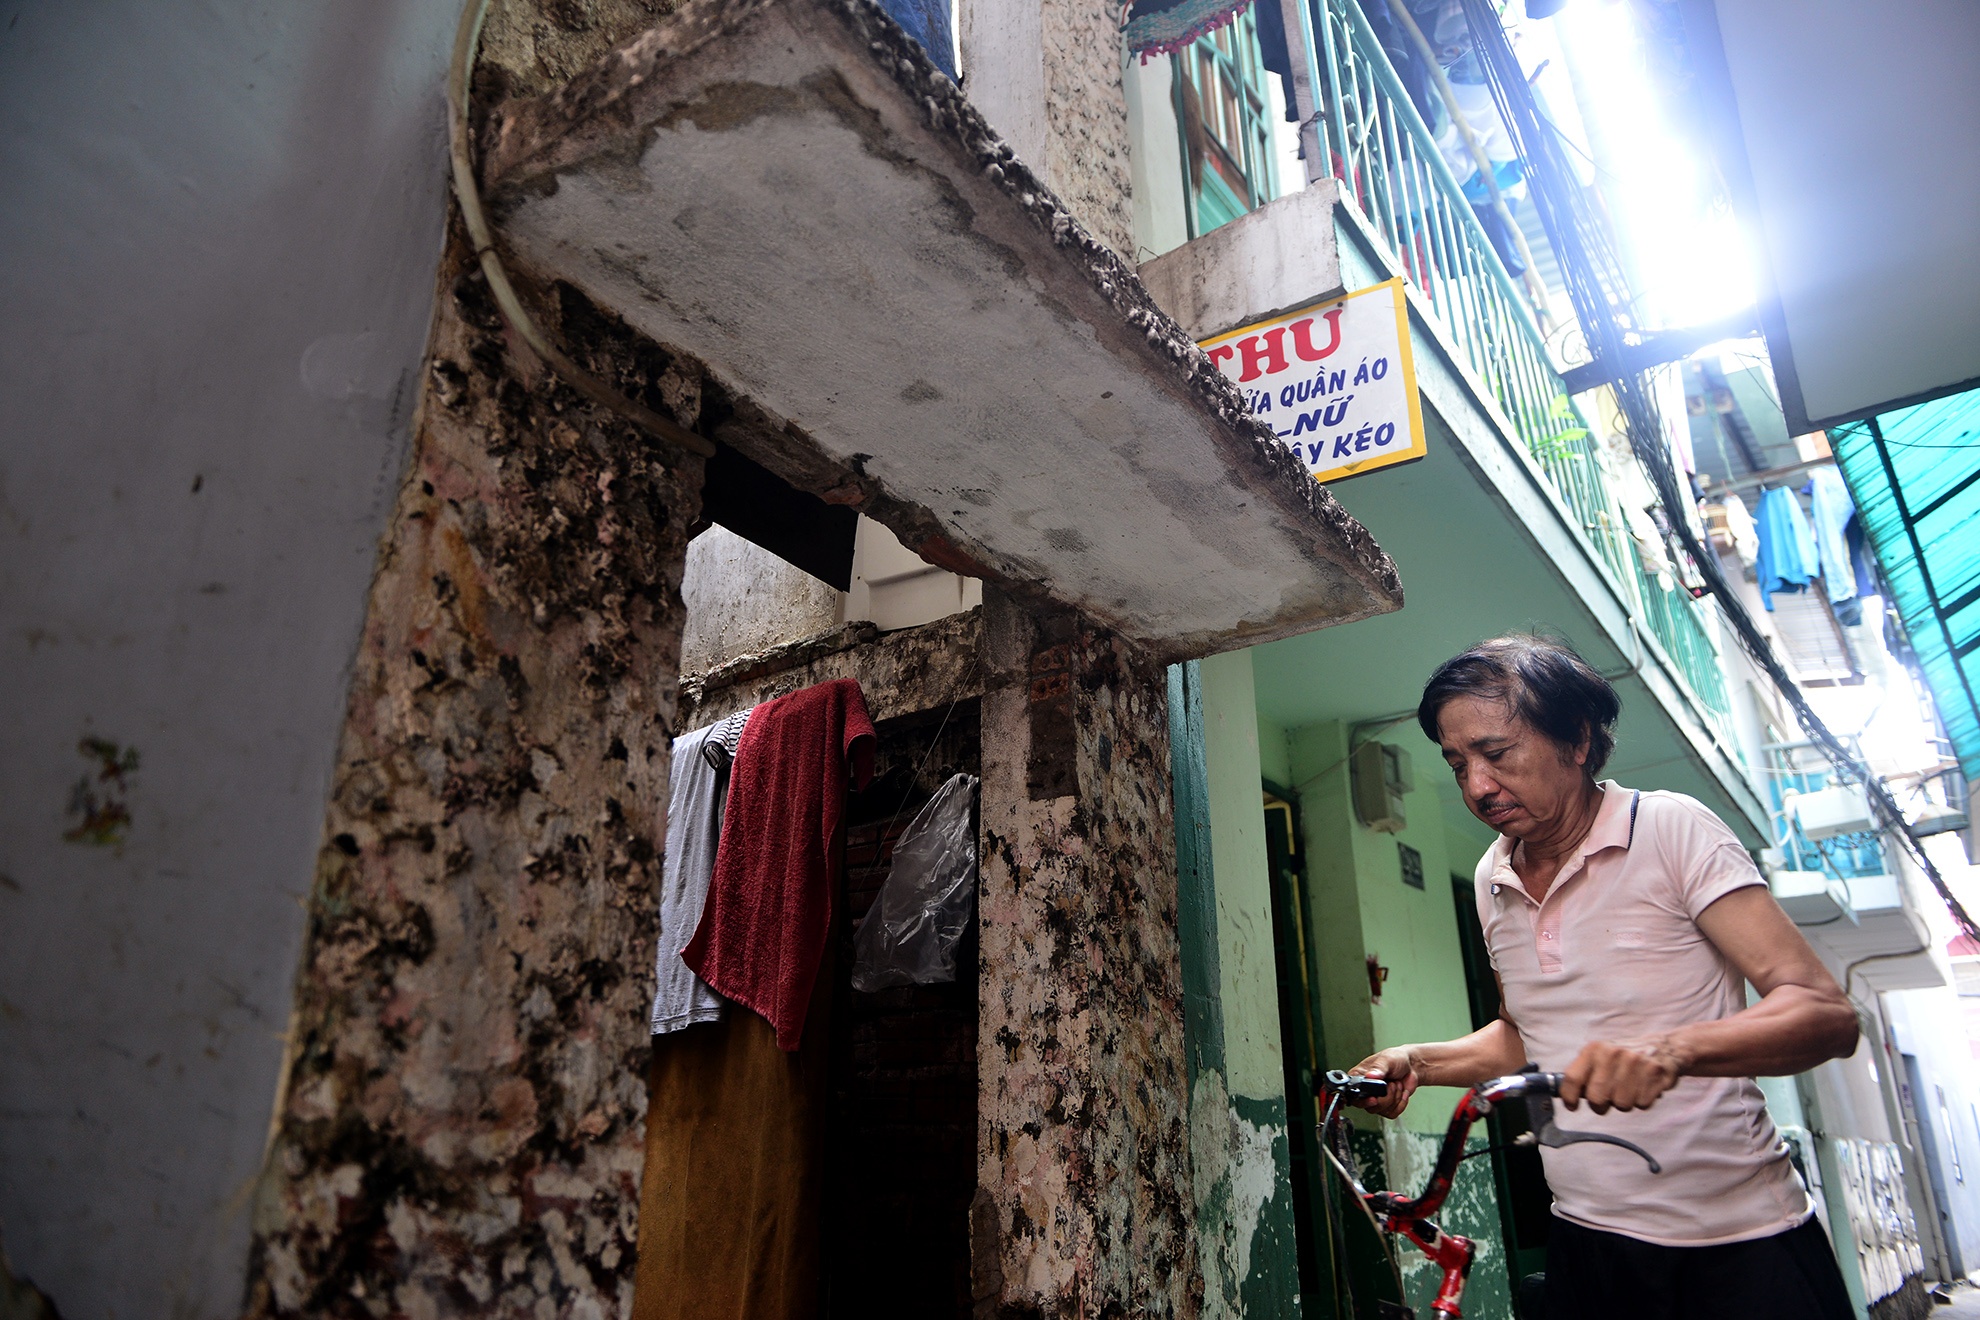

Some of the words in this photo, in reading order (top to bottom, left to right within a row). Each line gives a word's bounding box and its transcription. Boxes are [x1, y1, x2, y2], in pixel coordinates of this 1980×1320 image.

[1244, 388, 1272, 415] ỬA
[1279, 365, 1347, 408] QUẦN
[1353, 356, 1388, 387] ÁO
[1291, 441, 1325, 465] ÂY
[1332, 421, 1396, 459] KÉO
